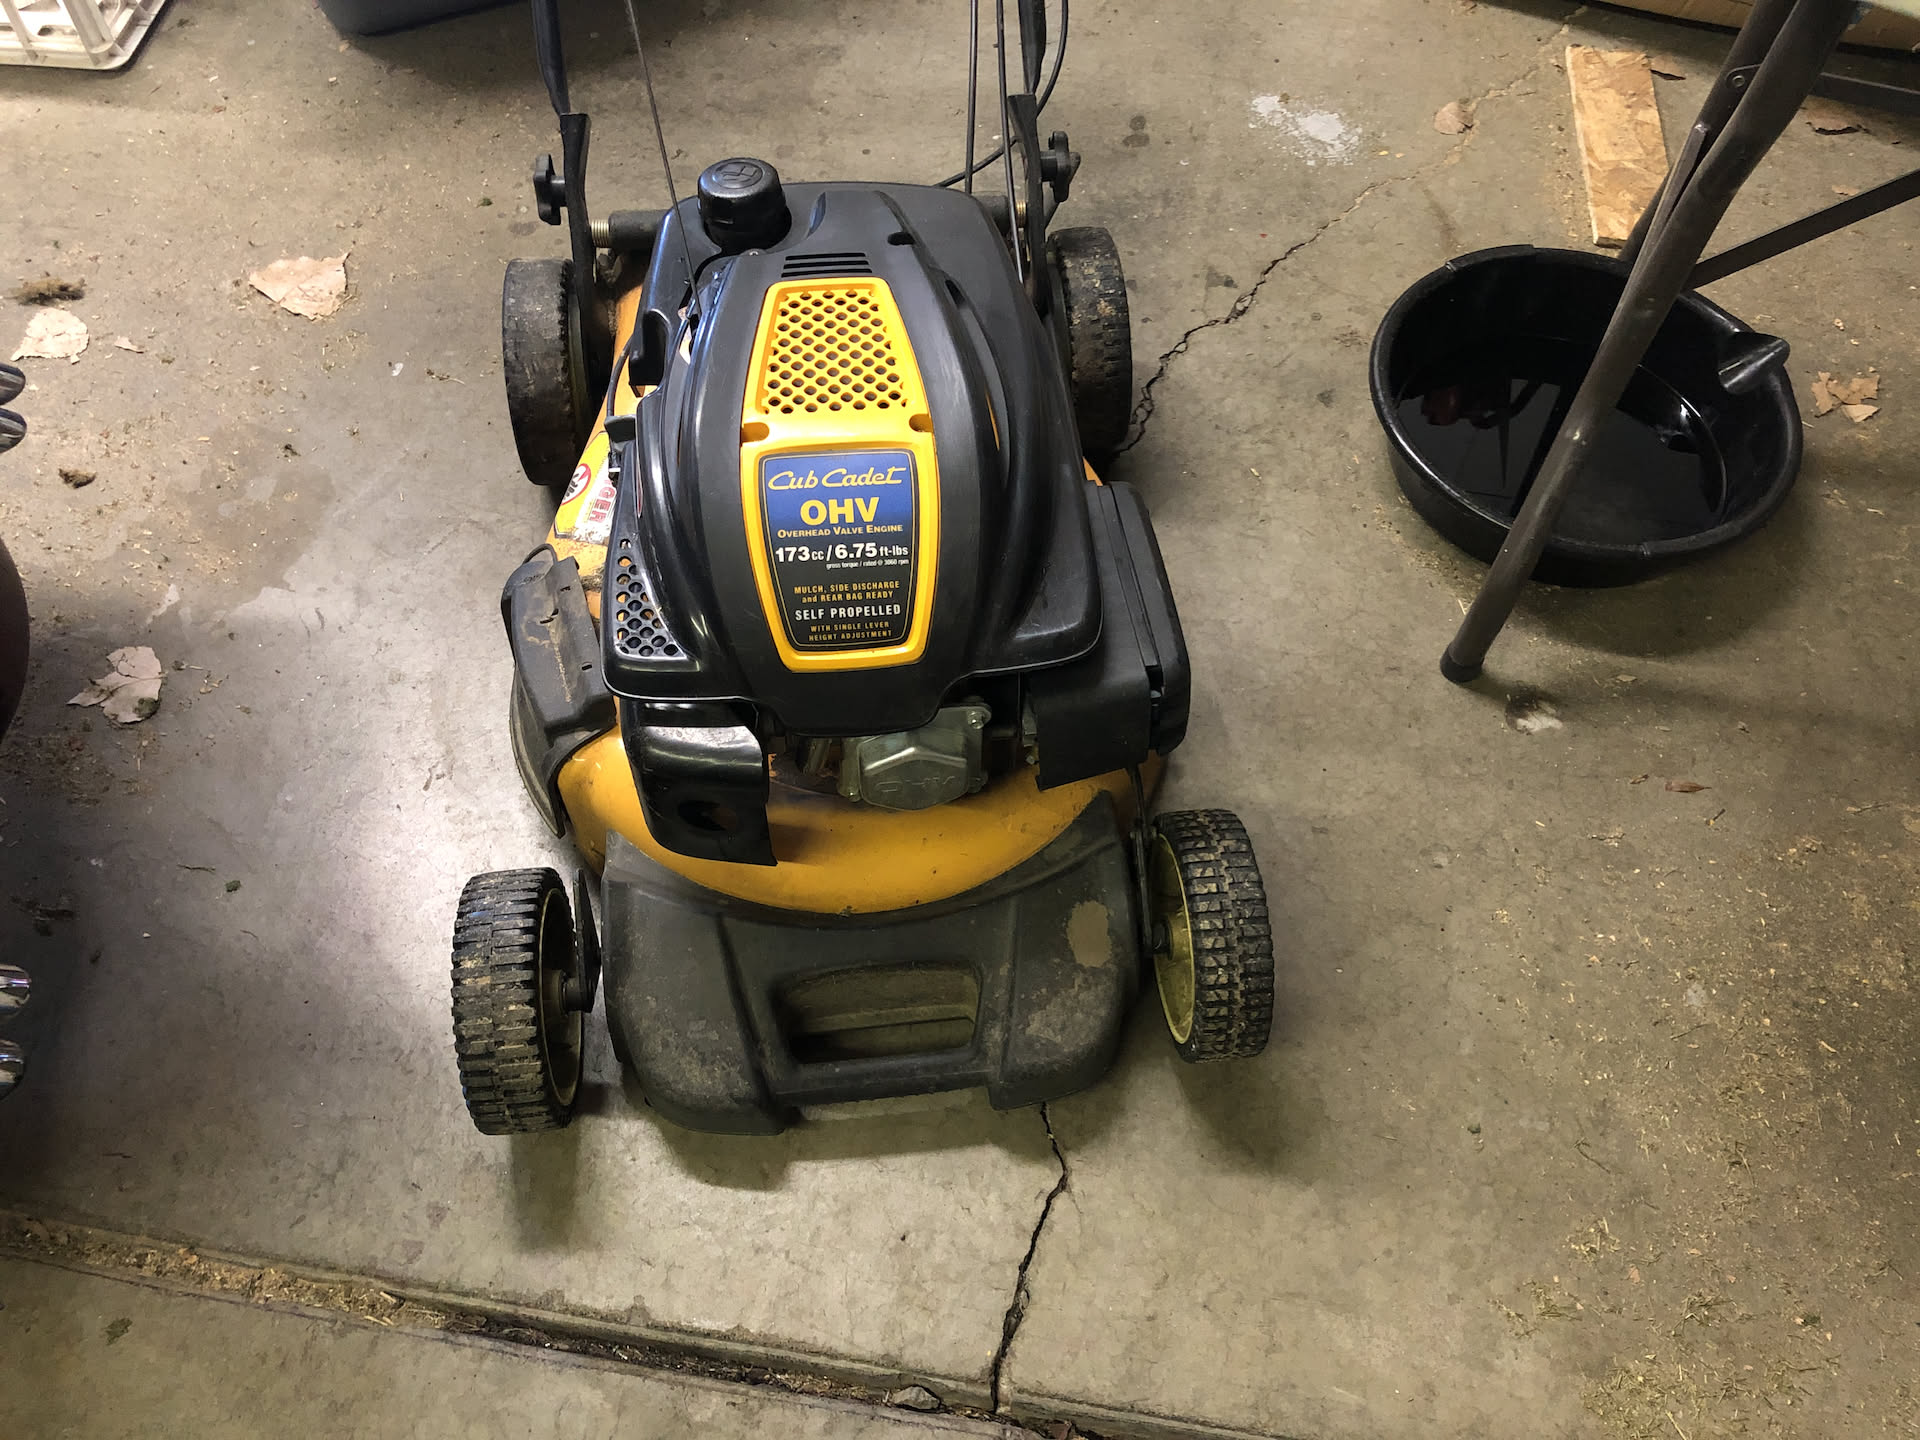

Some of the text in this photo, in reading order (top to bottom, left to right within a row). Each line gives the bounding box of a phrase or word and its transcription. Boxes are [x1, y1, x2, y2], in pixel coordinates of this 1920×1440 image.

[768, 466, 906, 490] Cub Cadet
[800, 497, 880, 526] OHV
[778, 524, 904, 538] OVERHEAD VALVE ENGINE
[794, 580, 900, 594] MULCH, SIDE DISCHARGE
[802, 590, 894, 604] and REAR BAG READY
[796, 604, 900, 620] SELF PROPELLED
[834, 622, 862, 631] SINGLE
[864, 621, 890, 629] LEVER
[809, 630, 892, 641] HEIGHT ADJUSTMENT
